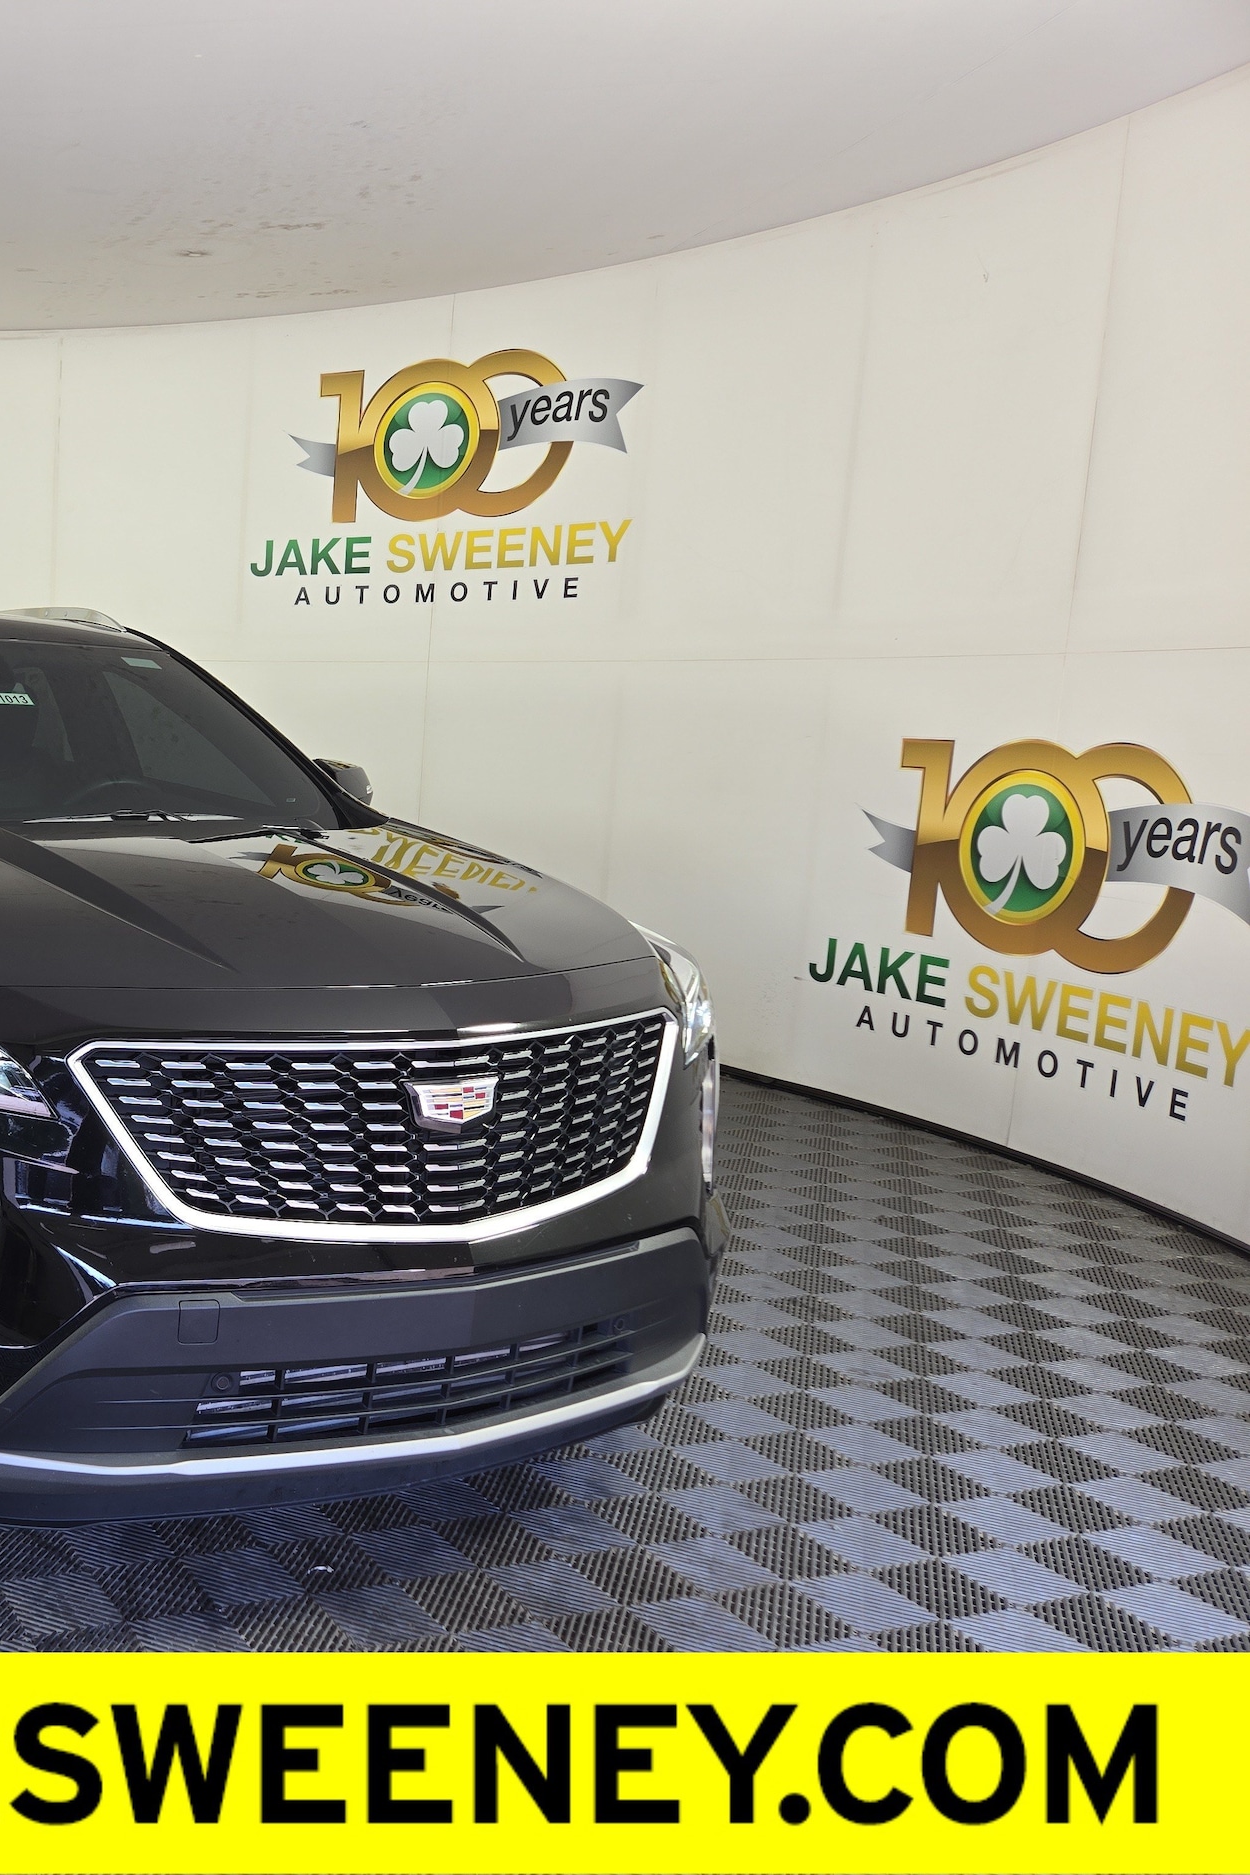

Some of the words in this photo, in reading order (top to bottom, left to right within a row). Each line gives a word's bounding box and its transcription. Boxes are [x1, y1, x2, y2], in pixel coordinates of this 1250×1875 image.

[507, 386, 611, 441] years
[250, 535, 373, 577] JAKE
[386, 519, 633, 574] SWEENEY
[294, 576, 579, 606] AUTOMOTIVE
[1116, 816, 1242, 875] years
[808, 937, 950, 1008] JAKE
[964, 965, 1250, 1088] SWEENEY
[855, 1005, 1189, 1122] AUTOMOTIVE
